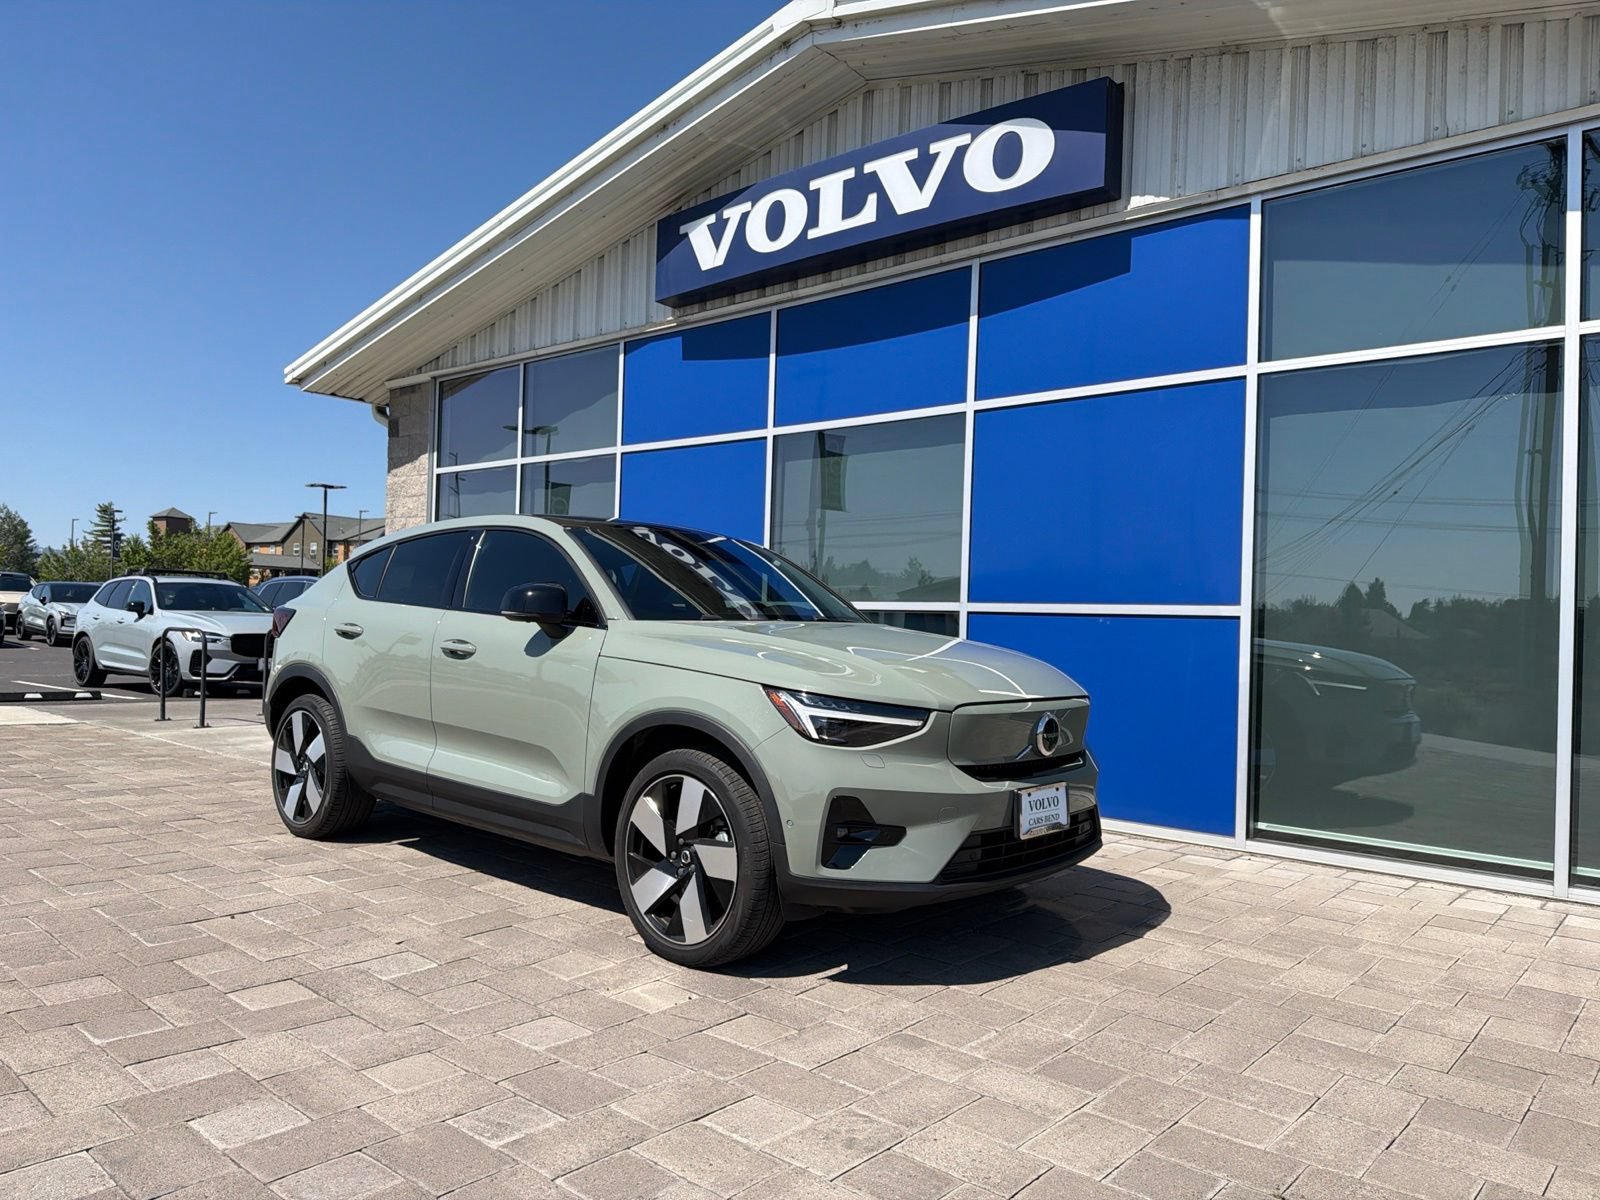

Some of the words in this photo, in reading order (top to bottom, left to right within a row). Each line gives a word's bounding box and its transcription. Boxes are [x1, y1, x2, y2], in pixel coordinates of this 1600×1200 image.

[679, 118, 1056, 271] VOLVO
[1028, 796, 1059, 812] VOLVO
[1028, 815, 1044, 826] CARS
[1044, 813, 1060, 823] BEND
